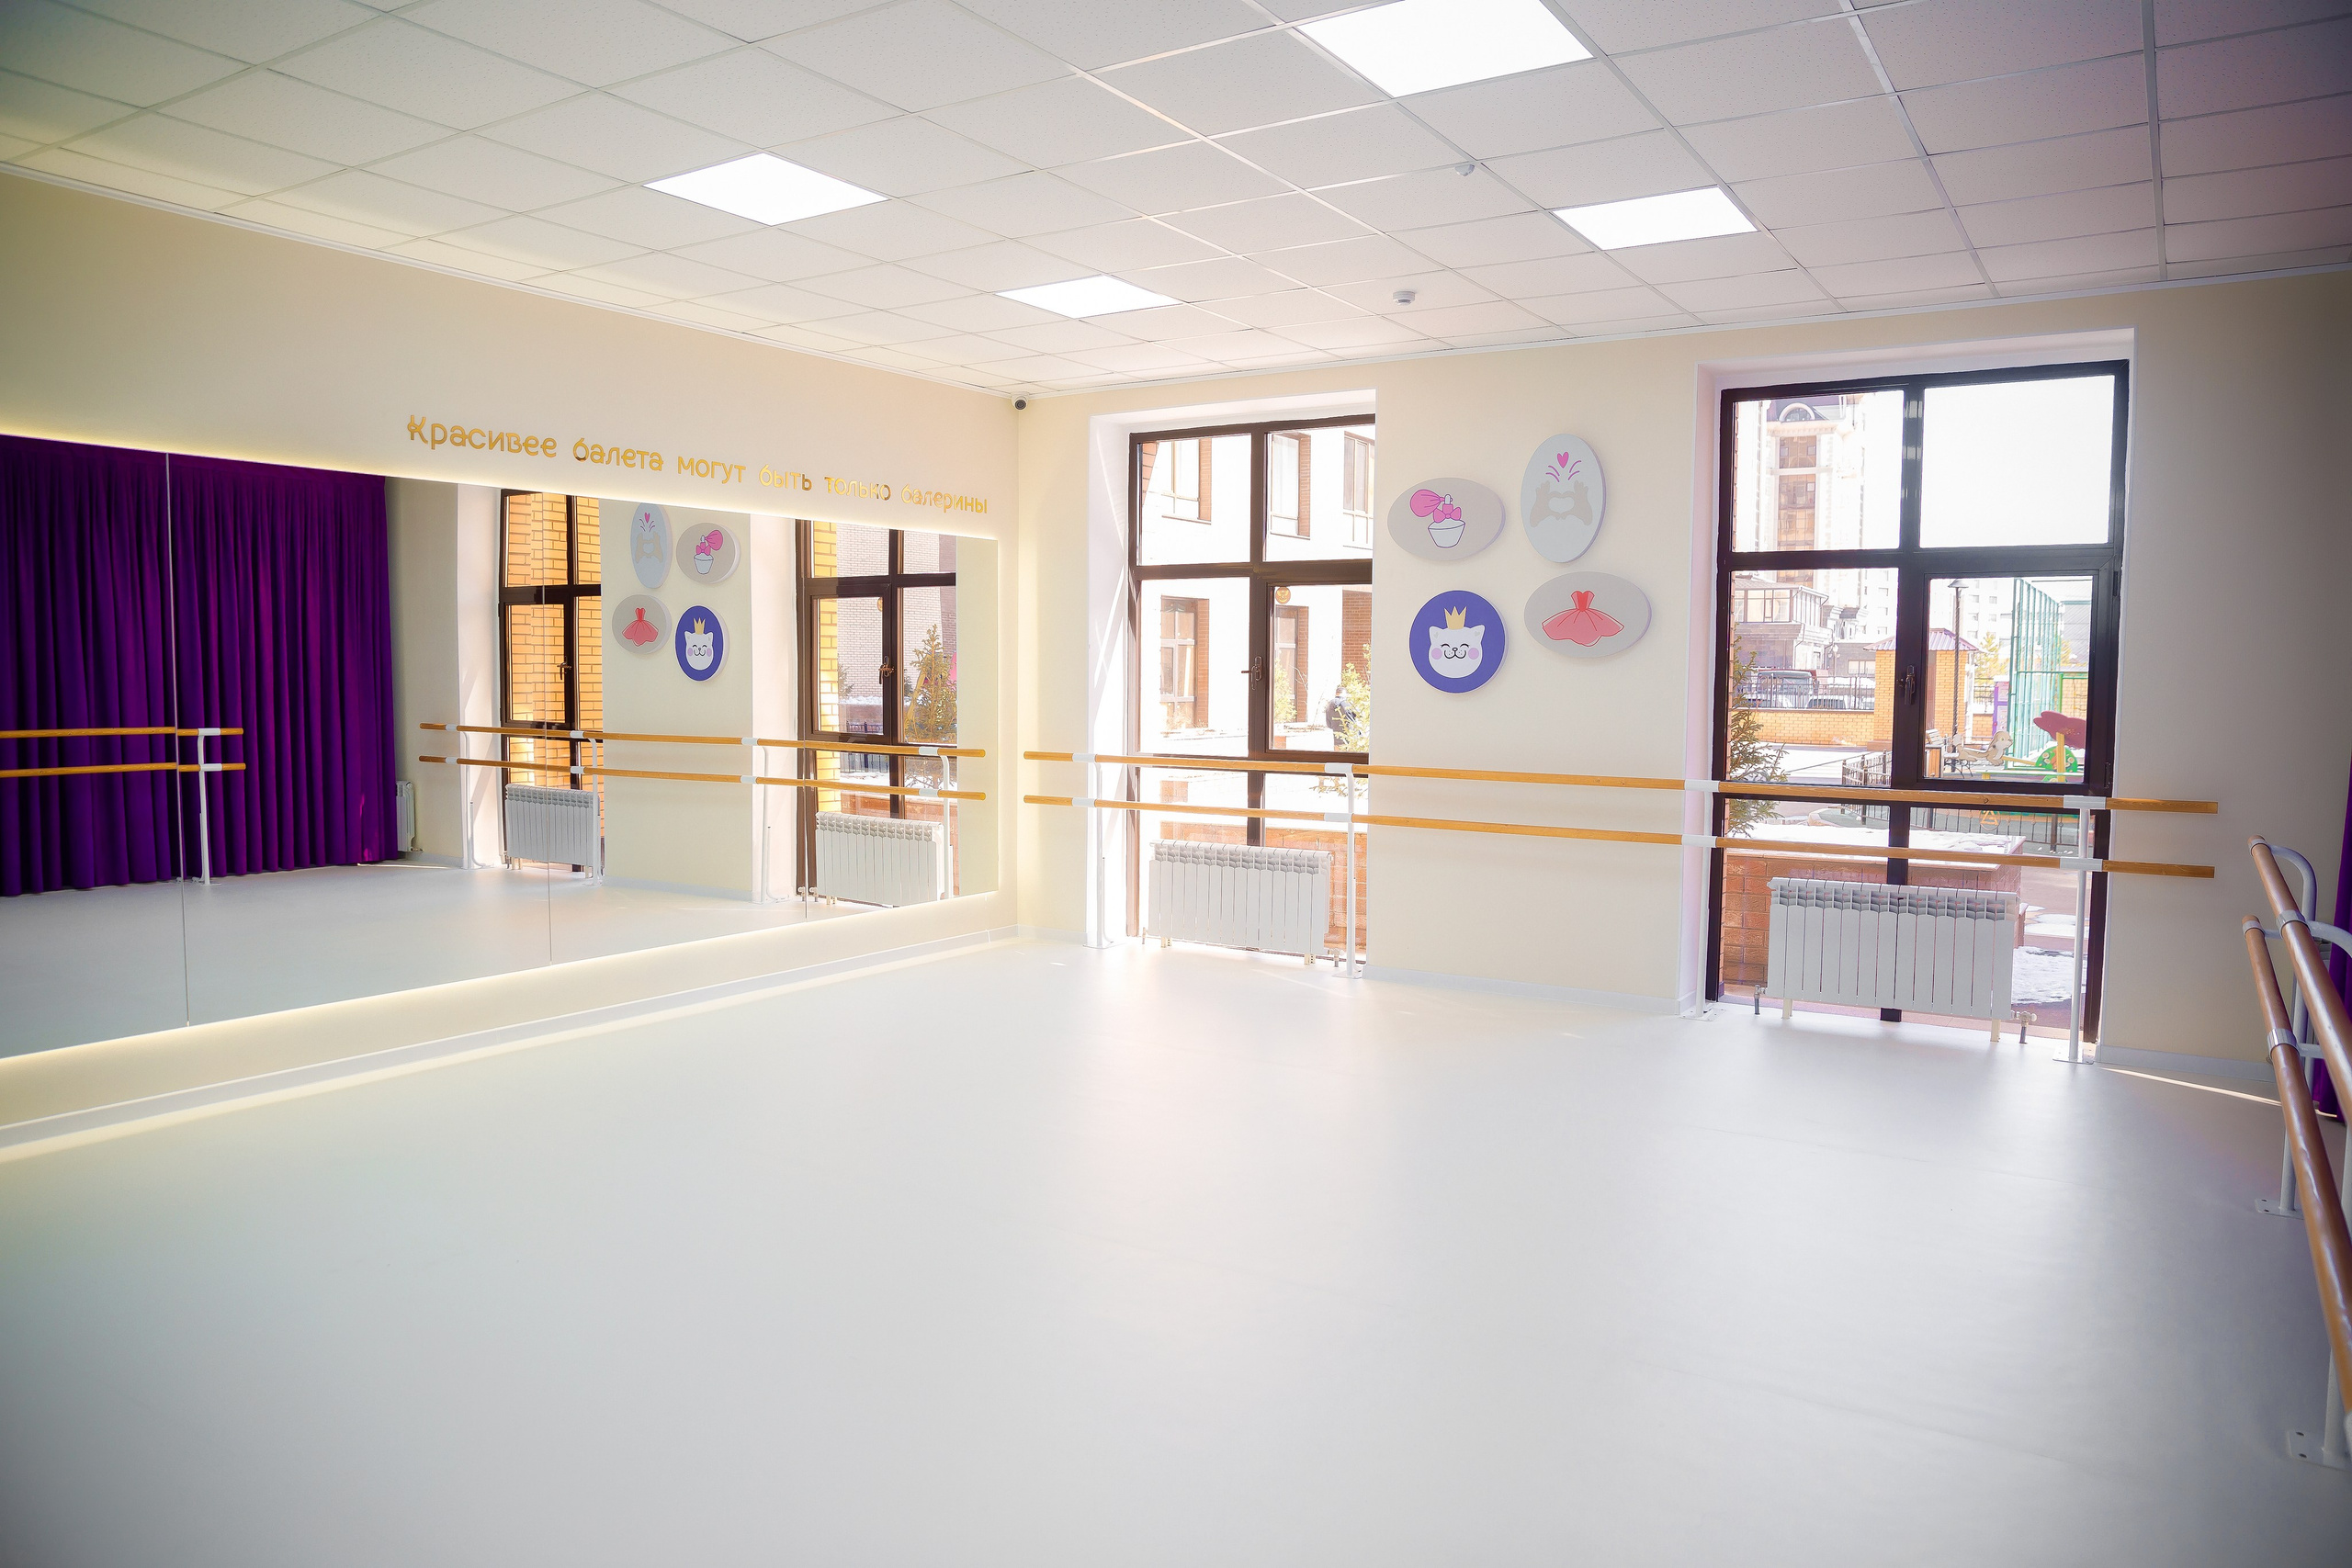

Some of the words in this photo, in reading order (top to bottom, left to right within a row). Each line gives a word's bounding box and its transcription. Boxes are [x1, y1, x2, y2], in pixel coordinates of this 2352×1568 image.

[407, 414, 558, 458] Красивее
[572, 437, 664, 472] балета
[677, 456, 747, 485] могут
[758, 464, 813, 491] быть
[824, 476, 892, 502] только
[900, 484, 989, 514] балерины
